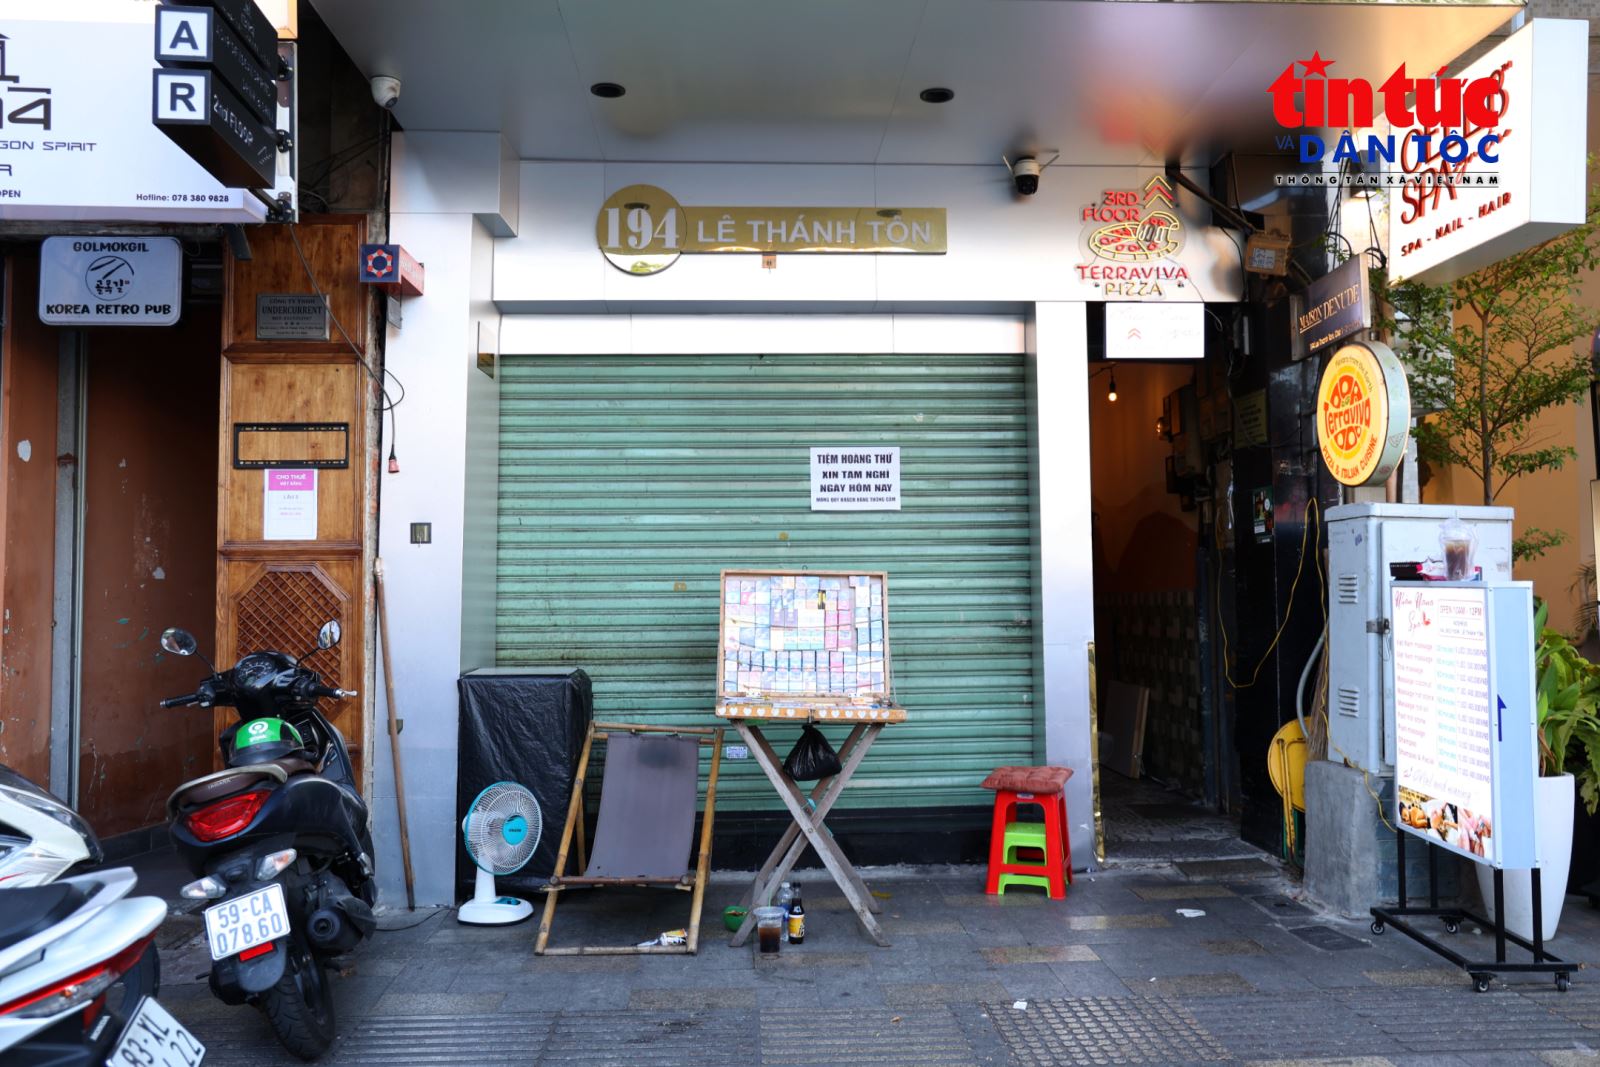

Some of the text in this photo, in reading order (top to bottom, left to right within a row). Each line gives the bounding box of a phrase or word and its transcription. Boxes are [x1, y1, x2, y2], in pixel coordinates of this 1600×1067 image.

[169, 20, 199, 50] A
[170, 82, 197, 112] R
[0, 97, 51, 131] 4
[42, 141, 97, 152] SPIRIT
[0, 190, 21, 198] PEN
[171, 194, 188, 202] 078
[208, 195, 229, 203] 9828
[1104, 191, 1138, 206] 3RD
[1083, 208, 1139, 222] FLOOR
[604, 207, 932, 249] 194 LÊ THÁNH TÔN
[1401, 238, 1423, 257] SPA
[1435, 217, 1464, 240] NAIL
[1478, 192, 1511, 218] HAIR
[73, 242, 149, 252] GOLMOKGIL
[1077, 265, 1188, 280] TERRAVIVA
[1105, 281, 1162, 296] PIZZA
[46, 304, 171, 315] KOREA RETRO PUB
[822, 470, 839, 479] XIN
[874, 483, 893, 492] NAY
[218, 893, 272, 928] 59-CA
[217, 913, 283, 954] 078.60
